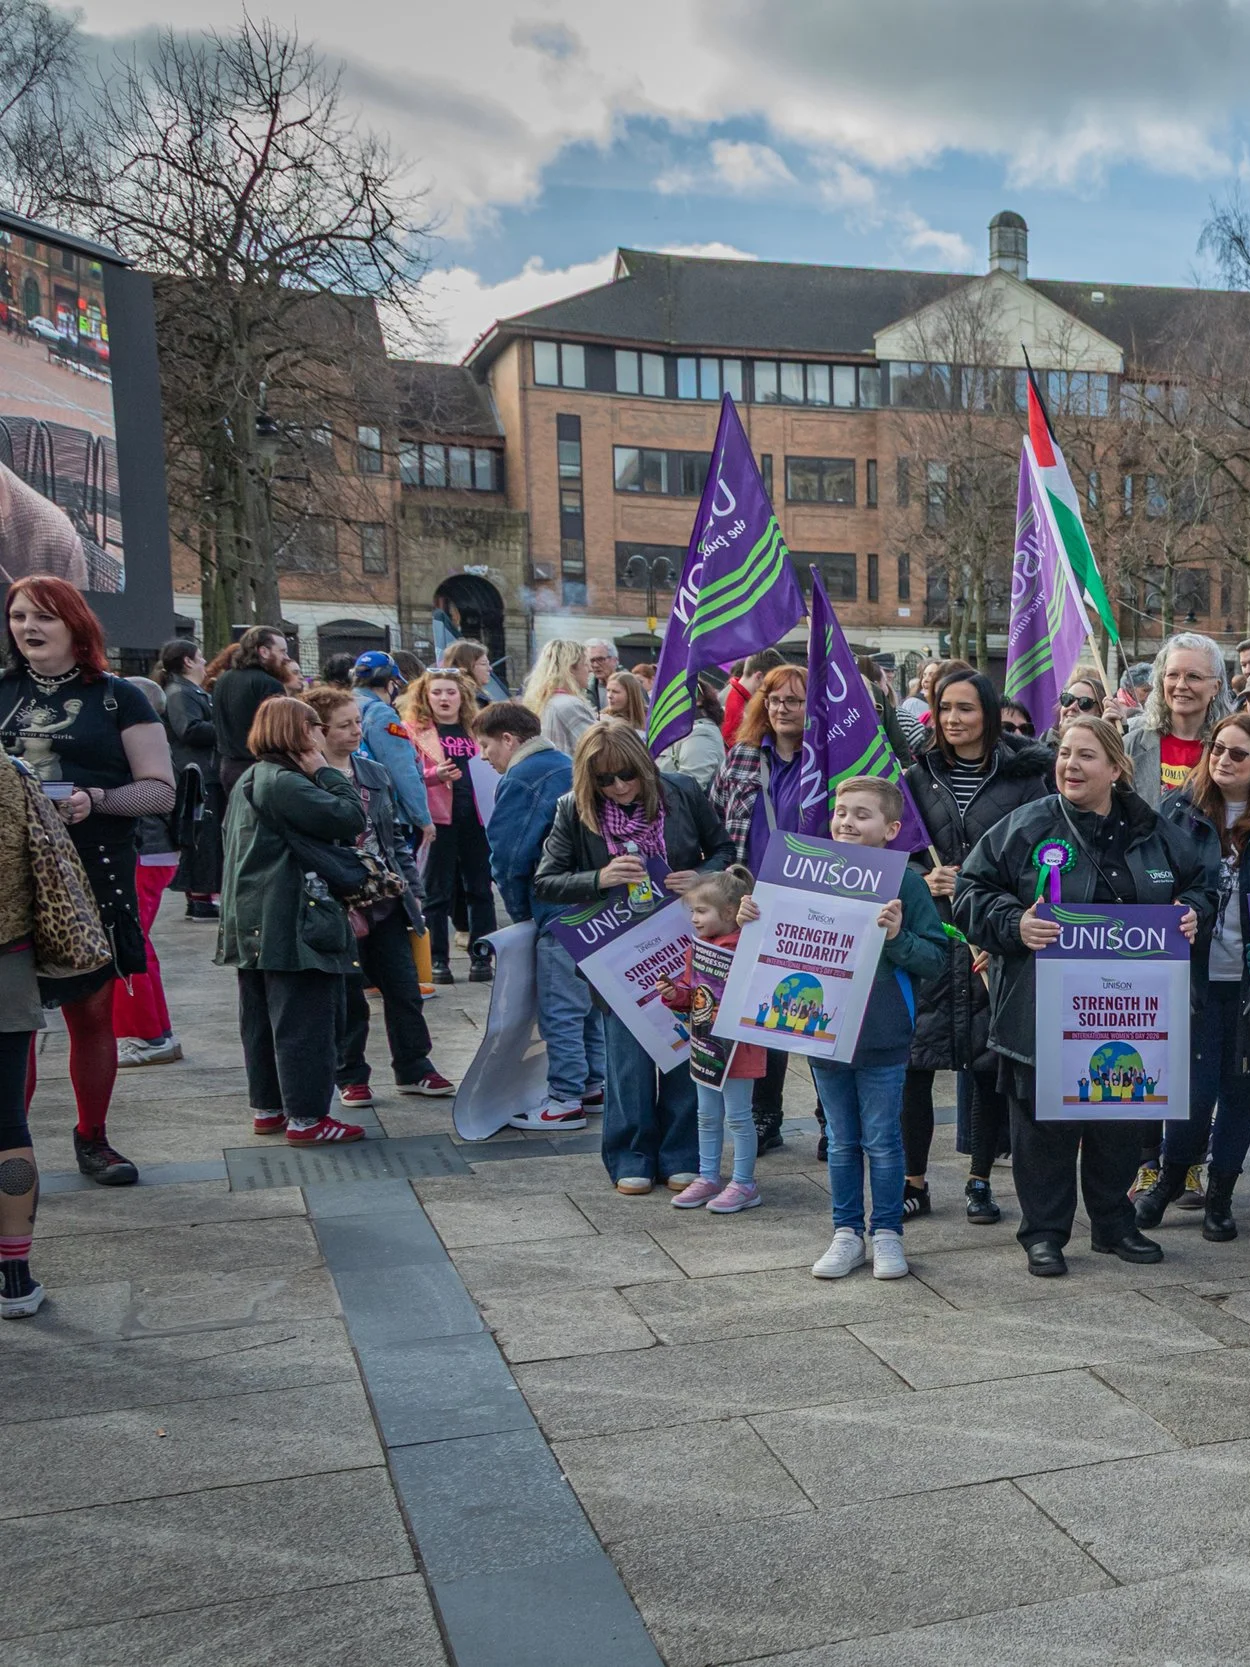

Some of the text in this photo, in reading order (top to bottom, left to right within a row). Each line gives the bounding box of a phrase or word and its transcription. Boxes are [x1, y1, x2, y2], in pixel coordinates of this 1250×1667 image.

[783, 855, 882, 892] UNISON
[577, 881, 664, 944] UNISN
[808, 913, 835, 925] UNISON
[775, 922, 854, 949] STRENGTH IN
[1059, 927, 1165, 950] UNISON
[625, 934, 692, 982] STRENGTH IN
[696, 953, 729, 970] OPPRESSIO
[776, 940, 849, 964] SOLIDARITY
[1073, 997, 1158, 1010] STRENGTH IN
[1079, 1012, 1156, 1026] SOLIDARITY
